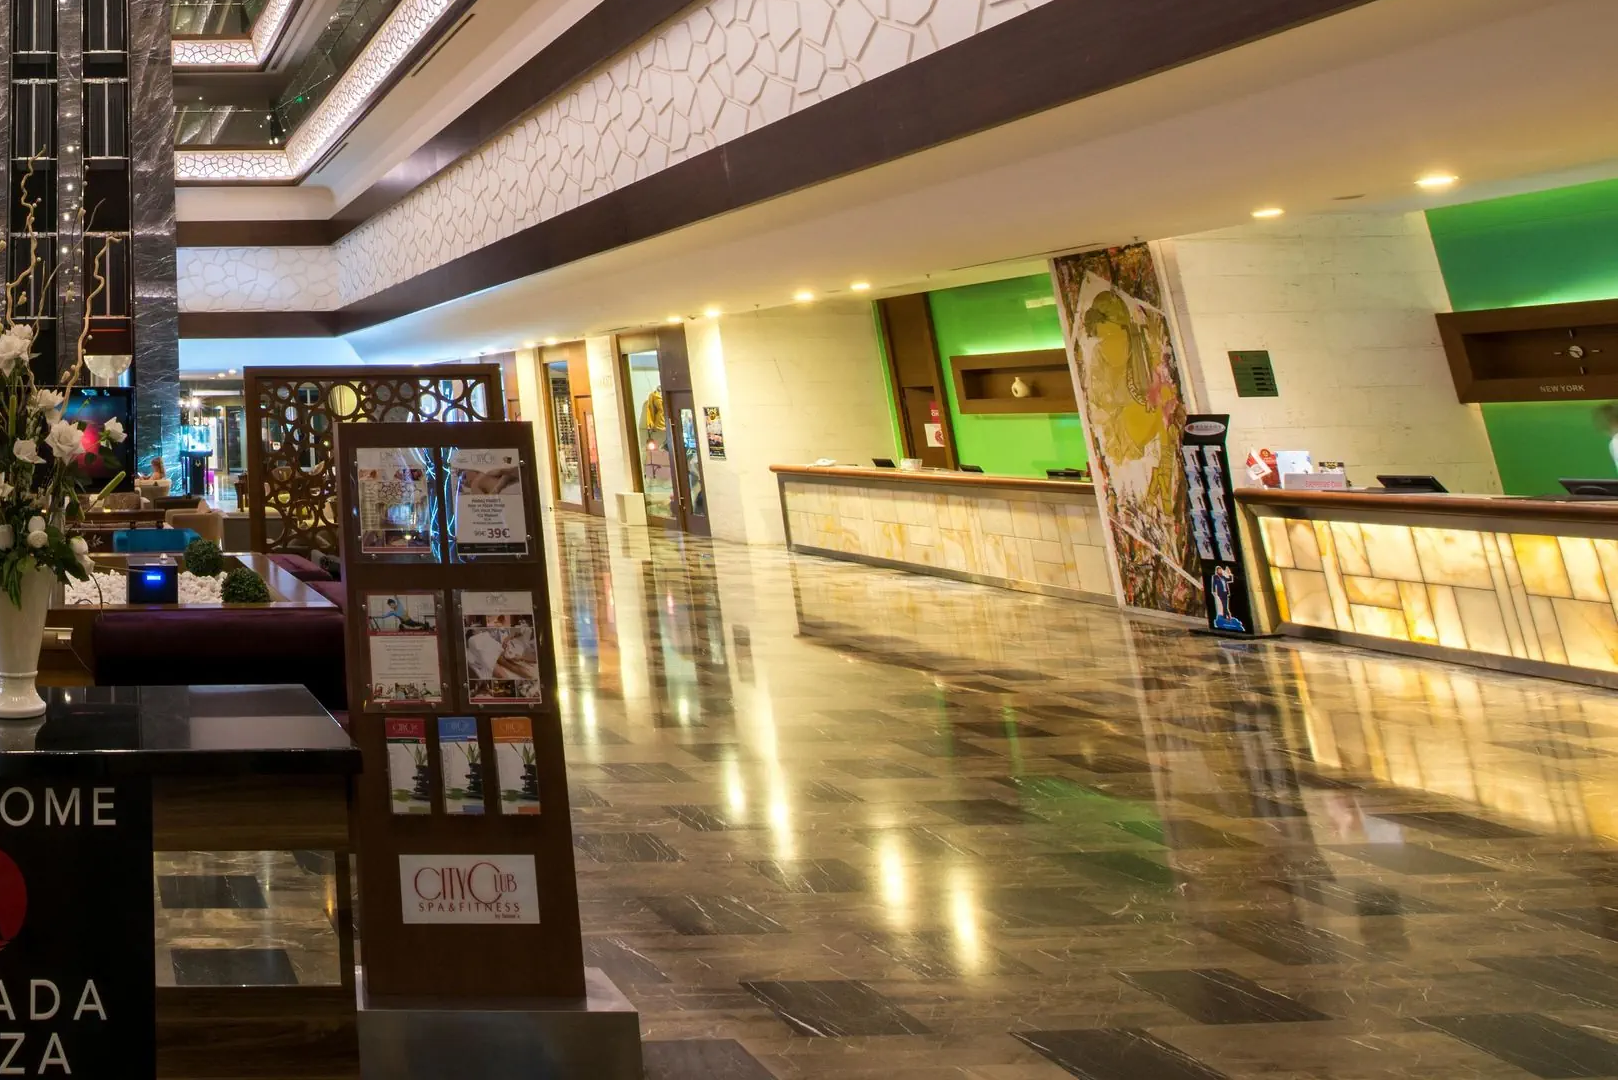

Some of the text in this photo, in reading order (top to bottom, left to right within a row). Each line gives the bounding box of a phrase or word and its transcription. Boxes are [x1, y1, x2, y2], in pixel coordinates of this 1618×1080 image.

[1539, 384, 1586, 393] NEW YORK
[487, 527, 511, 539] 39€
